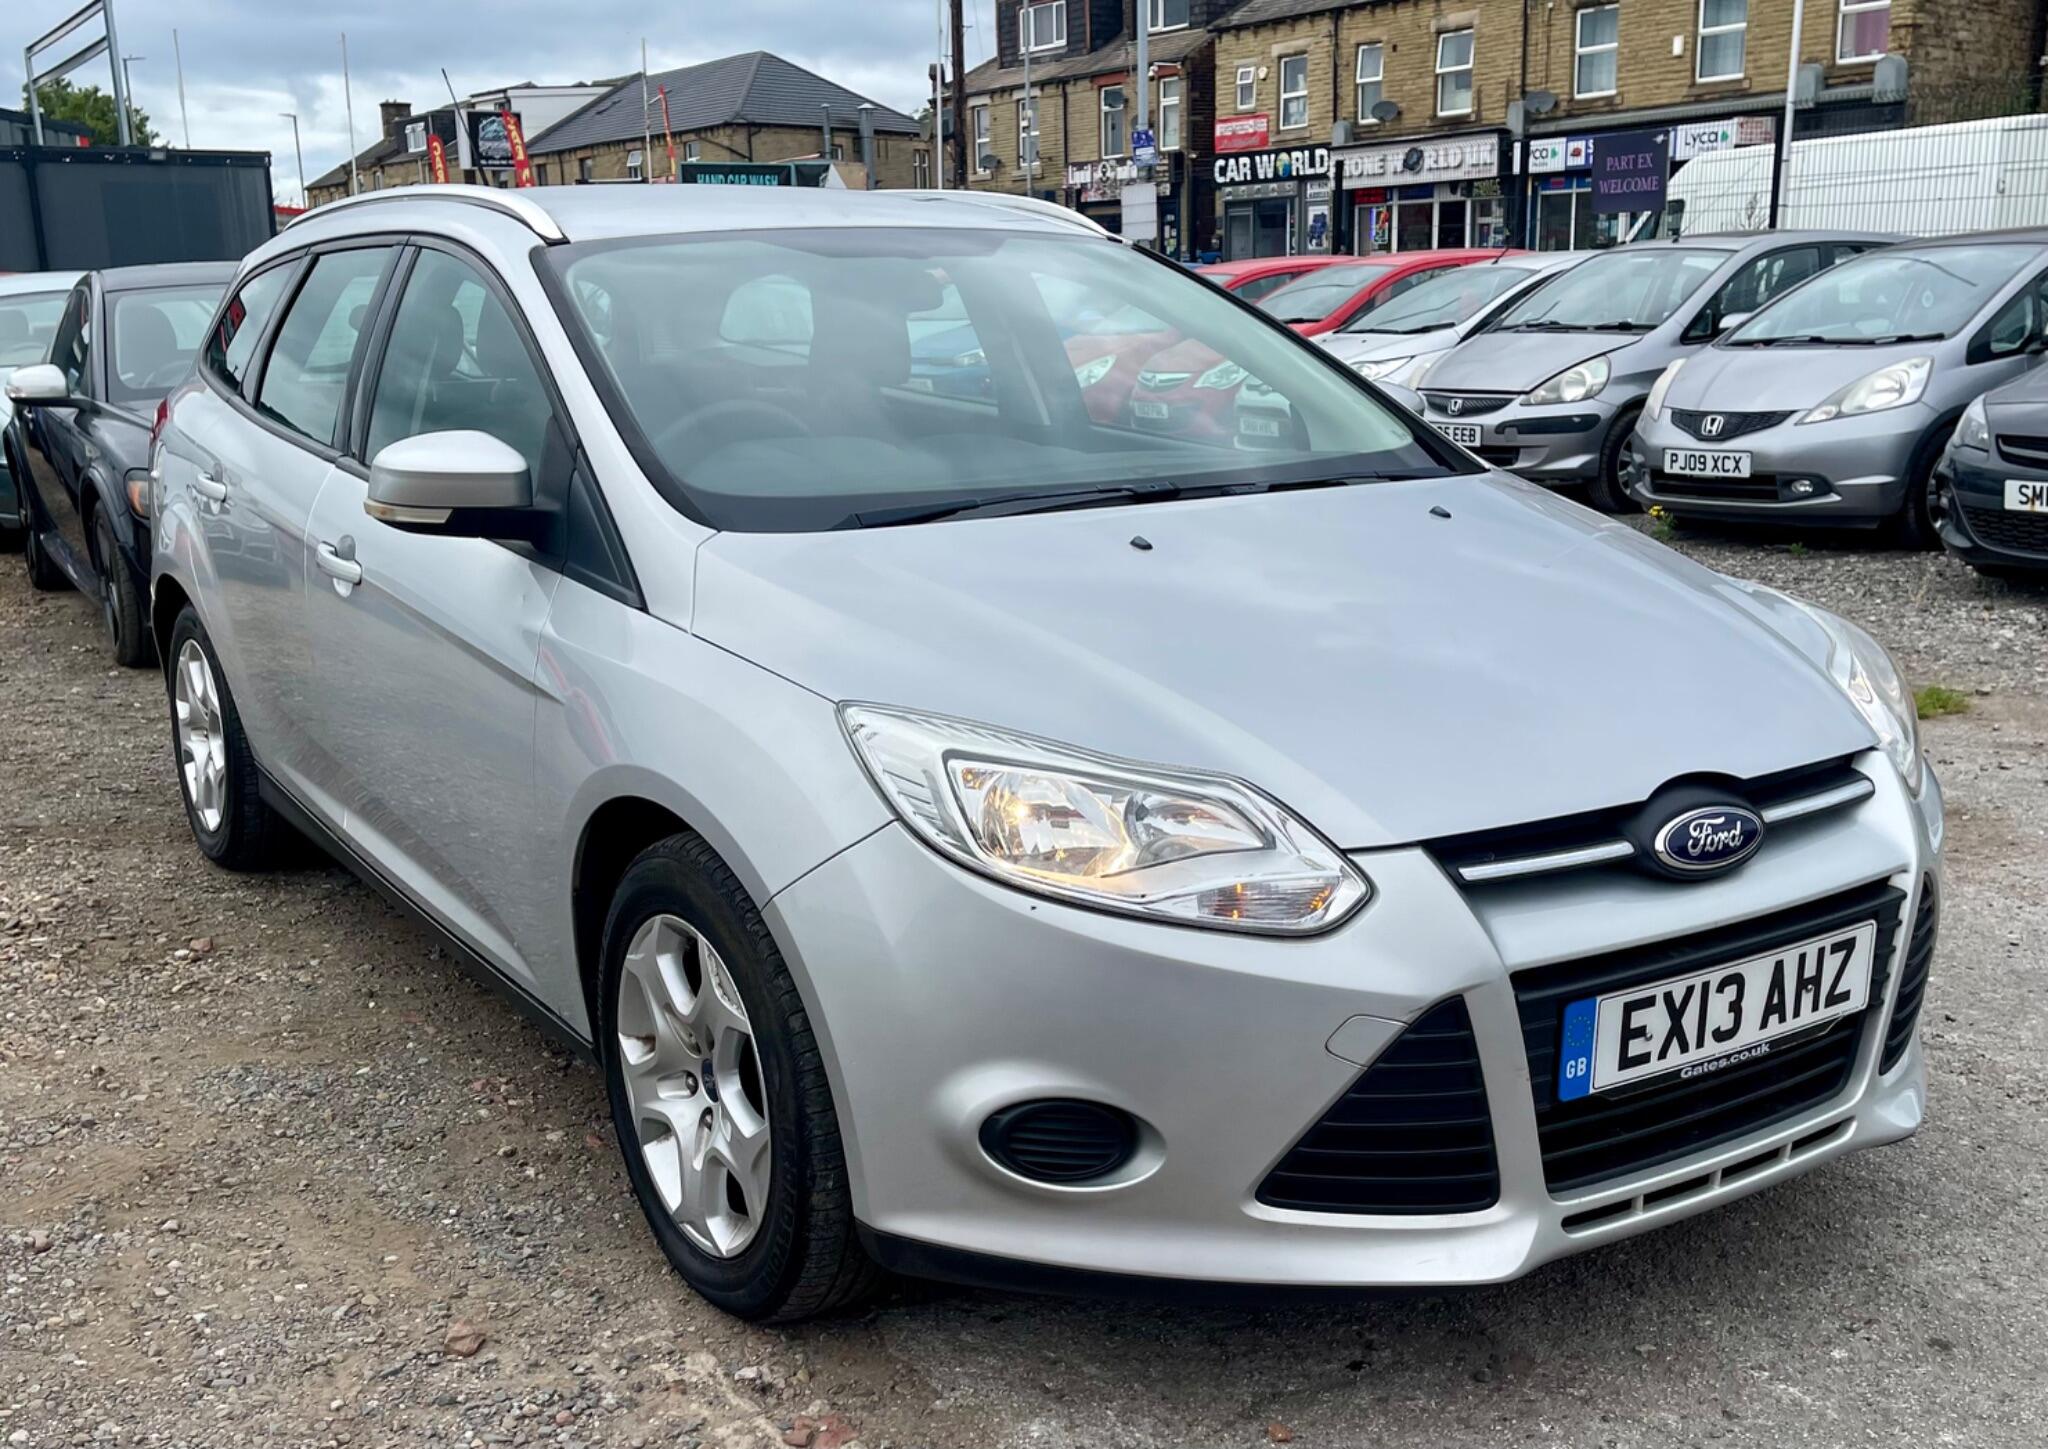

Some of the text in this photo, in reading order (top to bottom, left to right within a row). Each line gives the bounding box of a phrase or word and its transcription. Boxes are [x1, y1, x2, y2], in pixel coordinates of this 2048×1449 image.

[1684, 130, 1718, 148] Lyca
[1214, 147, 1329, 184] CAR WORLD
[1606, 153, 1653, 171] PART EX
[1599, 176, 1660, 195] WELCOME
[1452, 427, 1476, 443] EEB
[1669, 453, 1742, 473] PJ09 XCX
[1687, 816, 1743, 856] Ford
[1617, 936, 1857, 1072] EX13 AHZ
[1566, 1057, 1587, 1079] GB
[1680, 1042, 1771, 1079] Gates.co.uk
